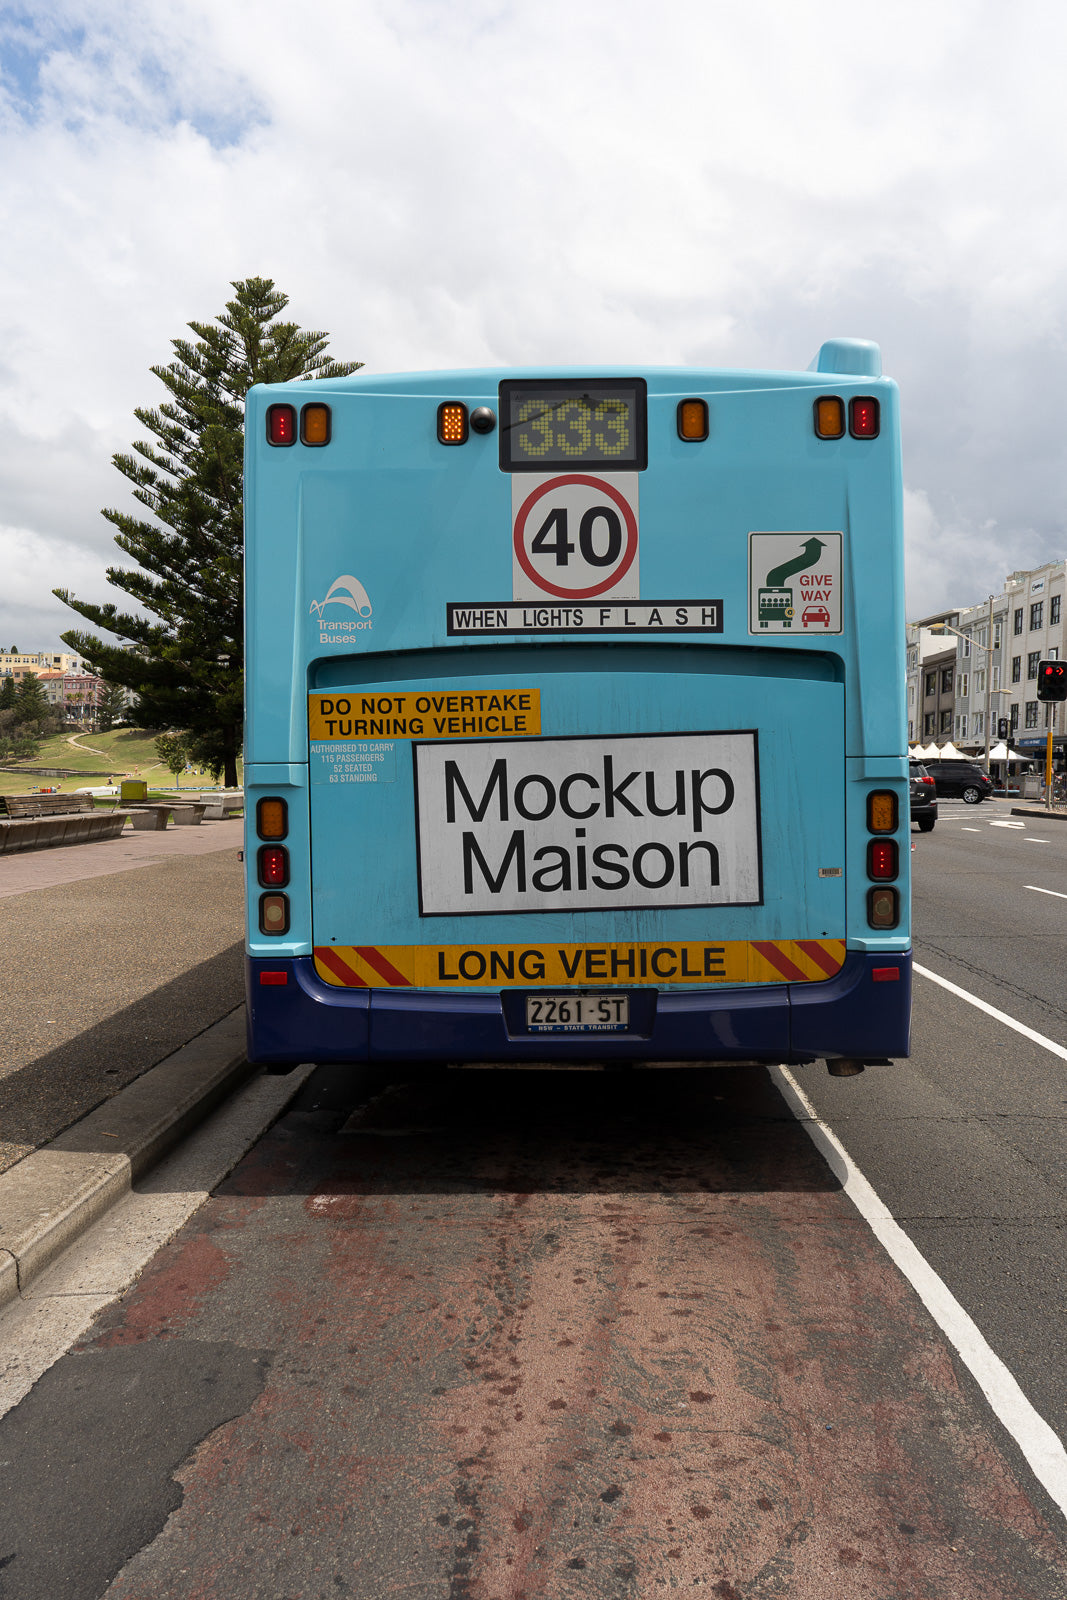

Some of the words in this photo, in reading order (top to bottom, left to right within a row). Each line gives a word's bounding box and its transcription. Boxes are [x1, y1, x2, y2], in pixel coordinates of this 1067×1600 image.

[519, 399, 629, 455] 333
[532, 506, 622, 567] 40
[800, 575, 832, 586] GIVE
[801, 590, 831, 601] WAY
[317, 619, 373, 632] Transport
[455, 610, 508, 628] WHEN
[523, 608, 583, 627] LIGHTS
[600, 607, 715, 626] FLASH
[320, 633, 356, 644] Buses
[320, 698, 351, 715] DO
[362, 697, 406, 714] NOT
[415, 694, 531, 714] OVERTAKE
[325, 718, 424, 736] TURNING
[433, 715, 527, 733] VEHICLE
[311, 744, 357, 753] AUTHORISED
[358, 743, 368, 752] TO
[369, 743, 394, 752] CARRY
[321, 754, 335, 763] 115
[336, 753, 384, 763] PASSENGERS
[333, 764, 343, 773] 52
[344, 763, 373, 772] SEATED
[340, 774, 378, 783] STANDING
[444, 755, 735, 833] Mockup
[462, 827, 720, 894] Maison
[438, 949, 546, 981] LONG
[558, 947, 727, 979] VEHICLE
[531, 1000, 625, 1023] 2261-ST
